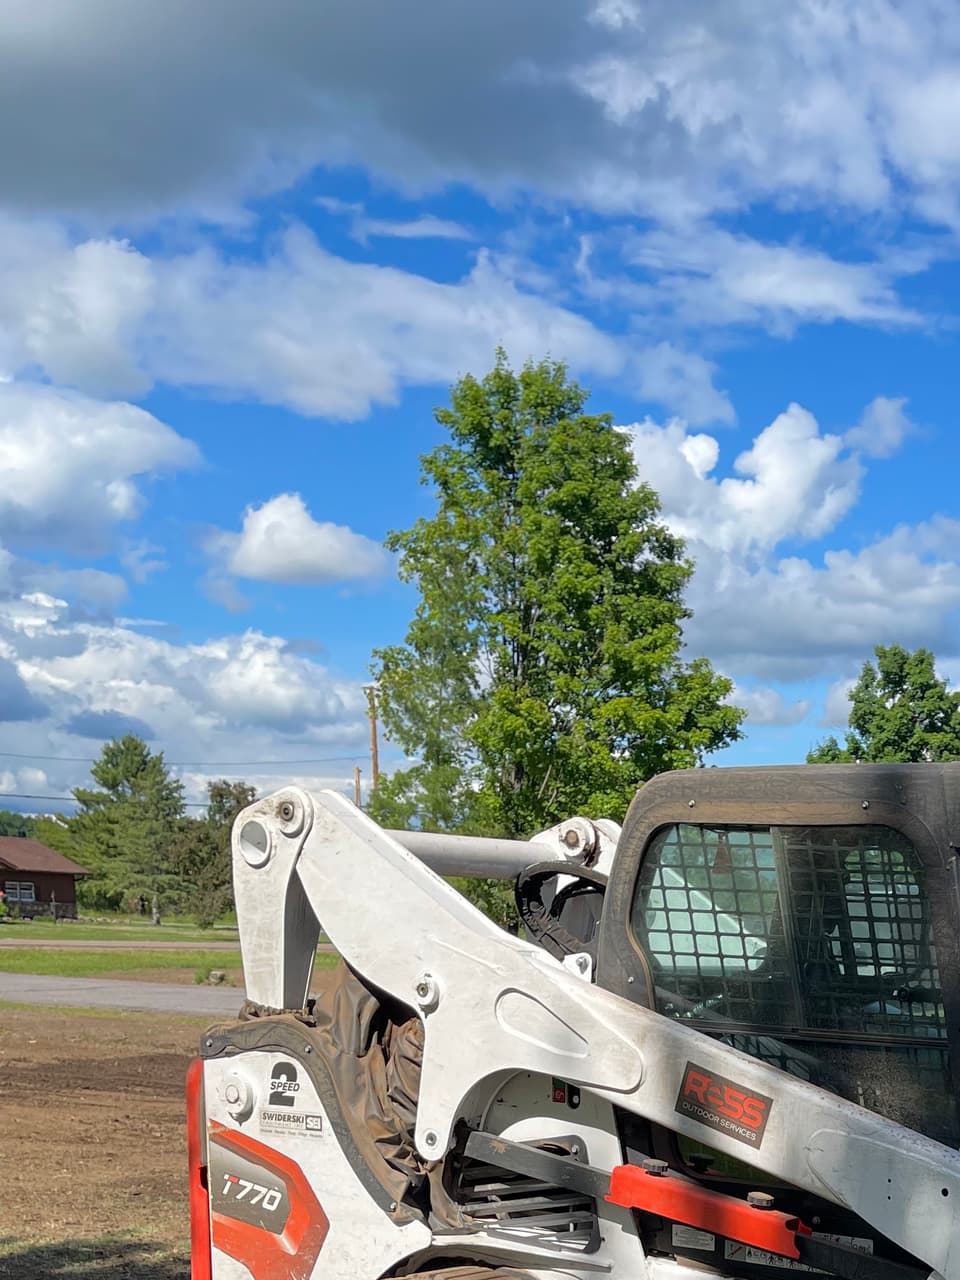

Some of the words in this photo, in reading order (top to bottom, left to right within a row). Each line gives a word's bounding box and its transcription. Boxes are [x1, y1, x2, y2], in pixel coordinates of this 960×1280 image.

[268, 1061, 298, 1106] 2
[270, 1081, 300, 1092] SPEED
[262, 1112, 305, 1124] SWIDERSKI
[682, 1101, 719, 1123] OUTDOOR
[719, 1119, 757, 1141] SERVICES
[222, 1174, 282, 1211] T770
